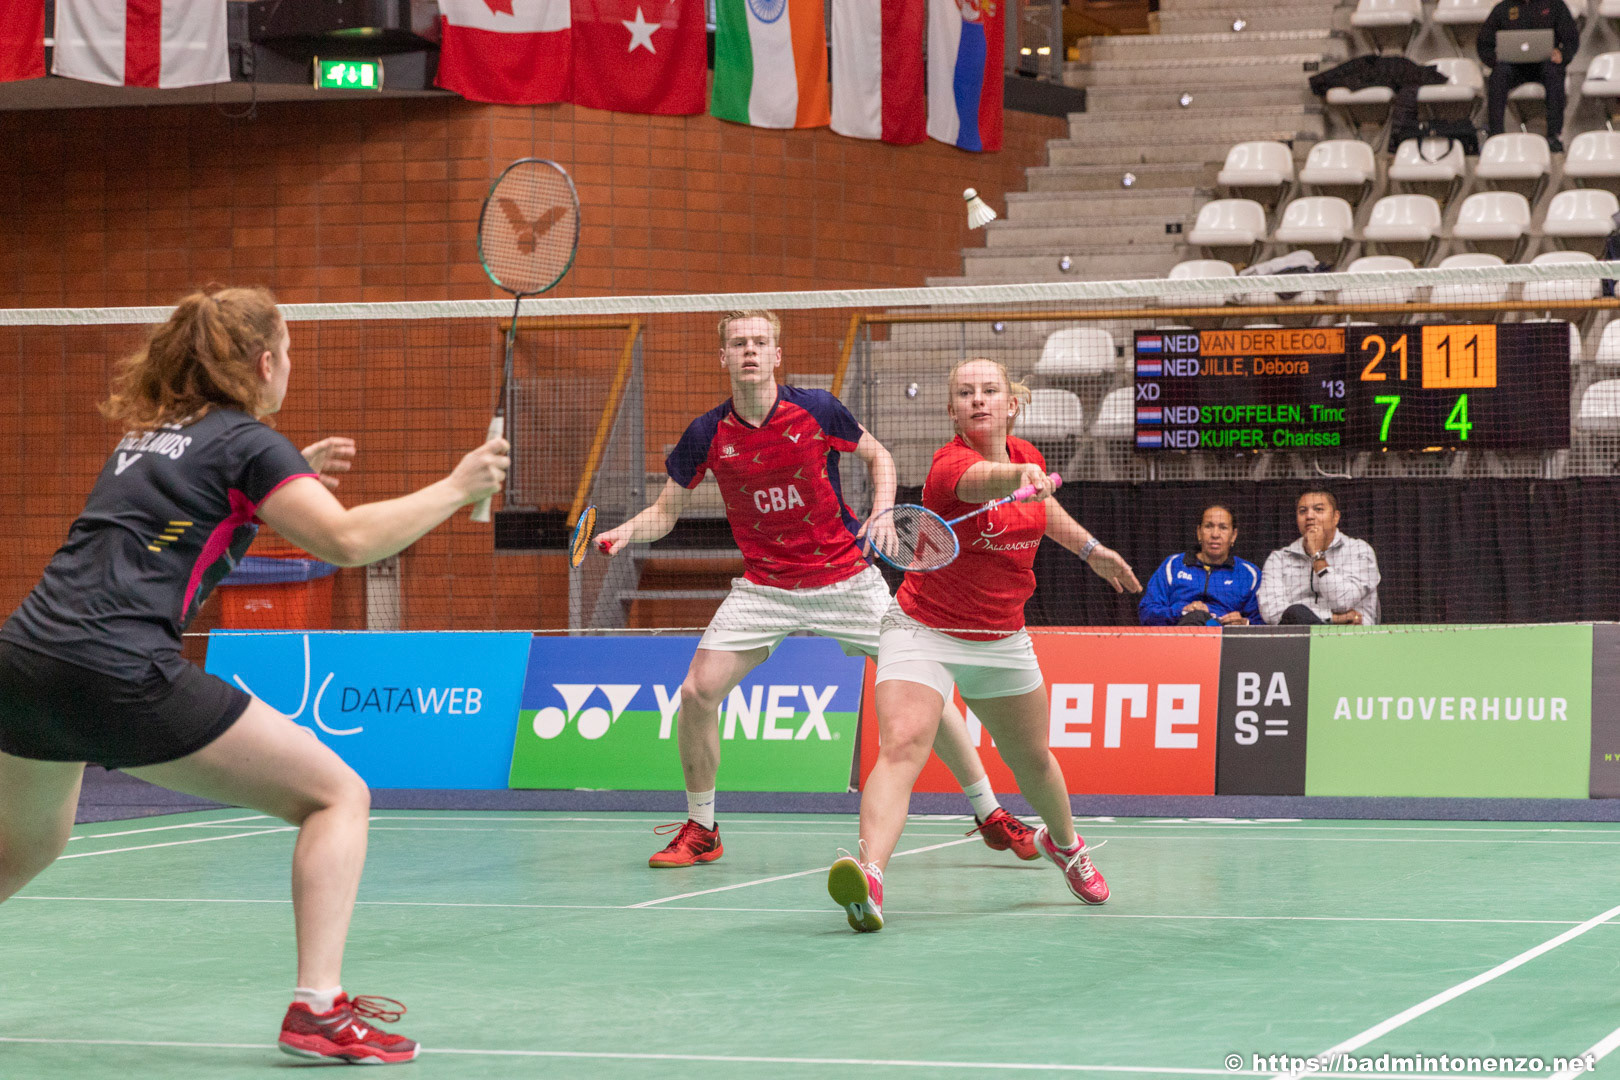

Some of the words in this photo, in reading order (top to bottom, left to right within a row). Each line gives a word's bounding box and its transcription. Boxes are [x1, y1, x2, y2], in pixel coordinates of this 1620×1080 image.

[1164, 335, 1199, 353] NED
[1200, 334, 1235, 351] VAN
[1240, 333, 1276, 350] DER
[1360, 333, 1408, 381] 21
[1437, 334, 1478, 378] 11
[1164, 359, 1199, 376] NED
[1200, 358, 1249, 377] JILLE,
[1253, 357, 1309, 375] Debora
[1136, 383, 1160, 400] XD
[1164, 406, 1199, 424] NED
[1201, 405, 1305, 424] STOFFELEN,
[1374, 395, 1401, 442] 7
[1444, 393, 1473, 441] 4
[1164, 430, 1199, 447] NED
[1201, 429, 1268, 449] KUIPER,
[1273, 428, 1340, 447] Charissa
[753, 485, 805, 514] CBA
[341, 687, 482, 715] DATAWEB
[1237, 671, 1291, 707] BA
[652, 684, 839, 741] YNEX
[1334, 696, 1568, 721] AUTOVERHUUR
